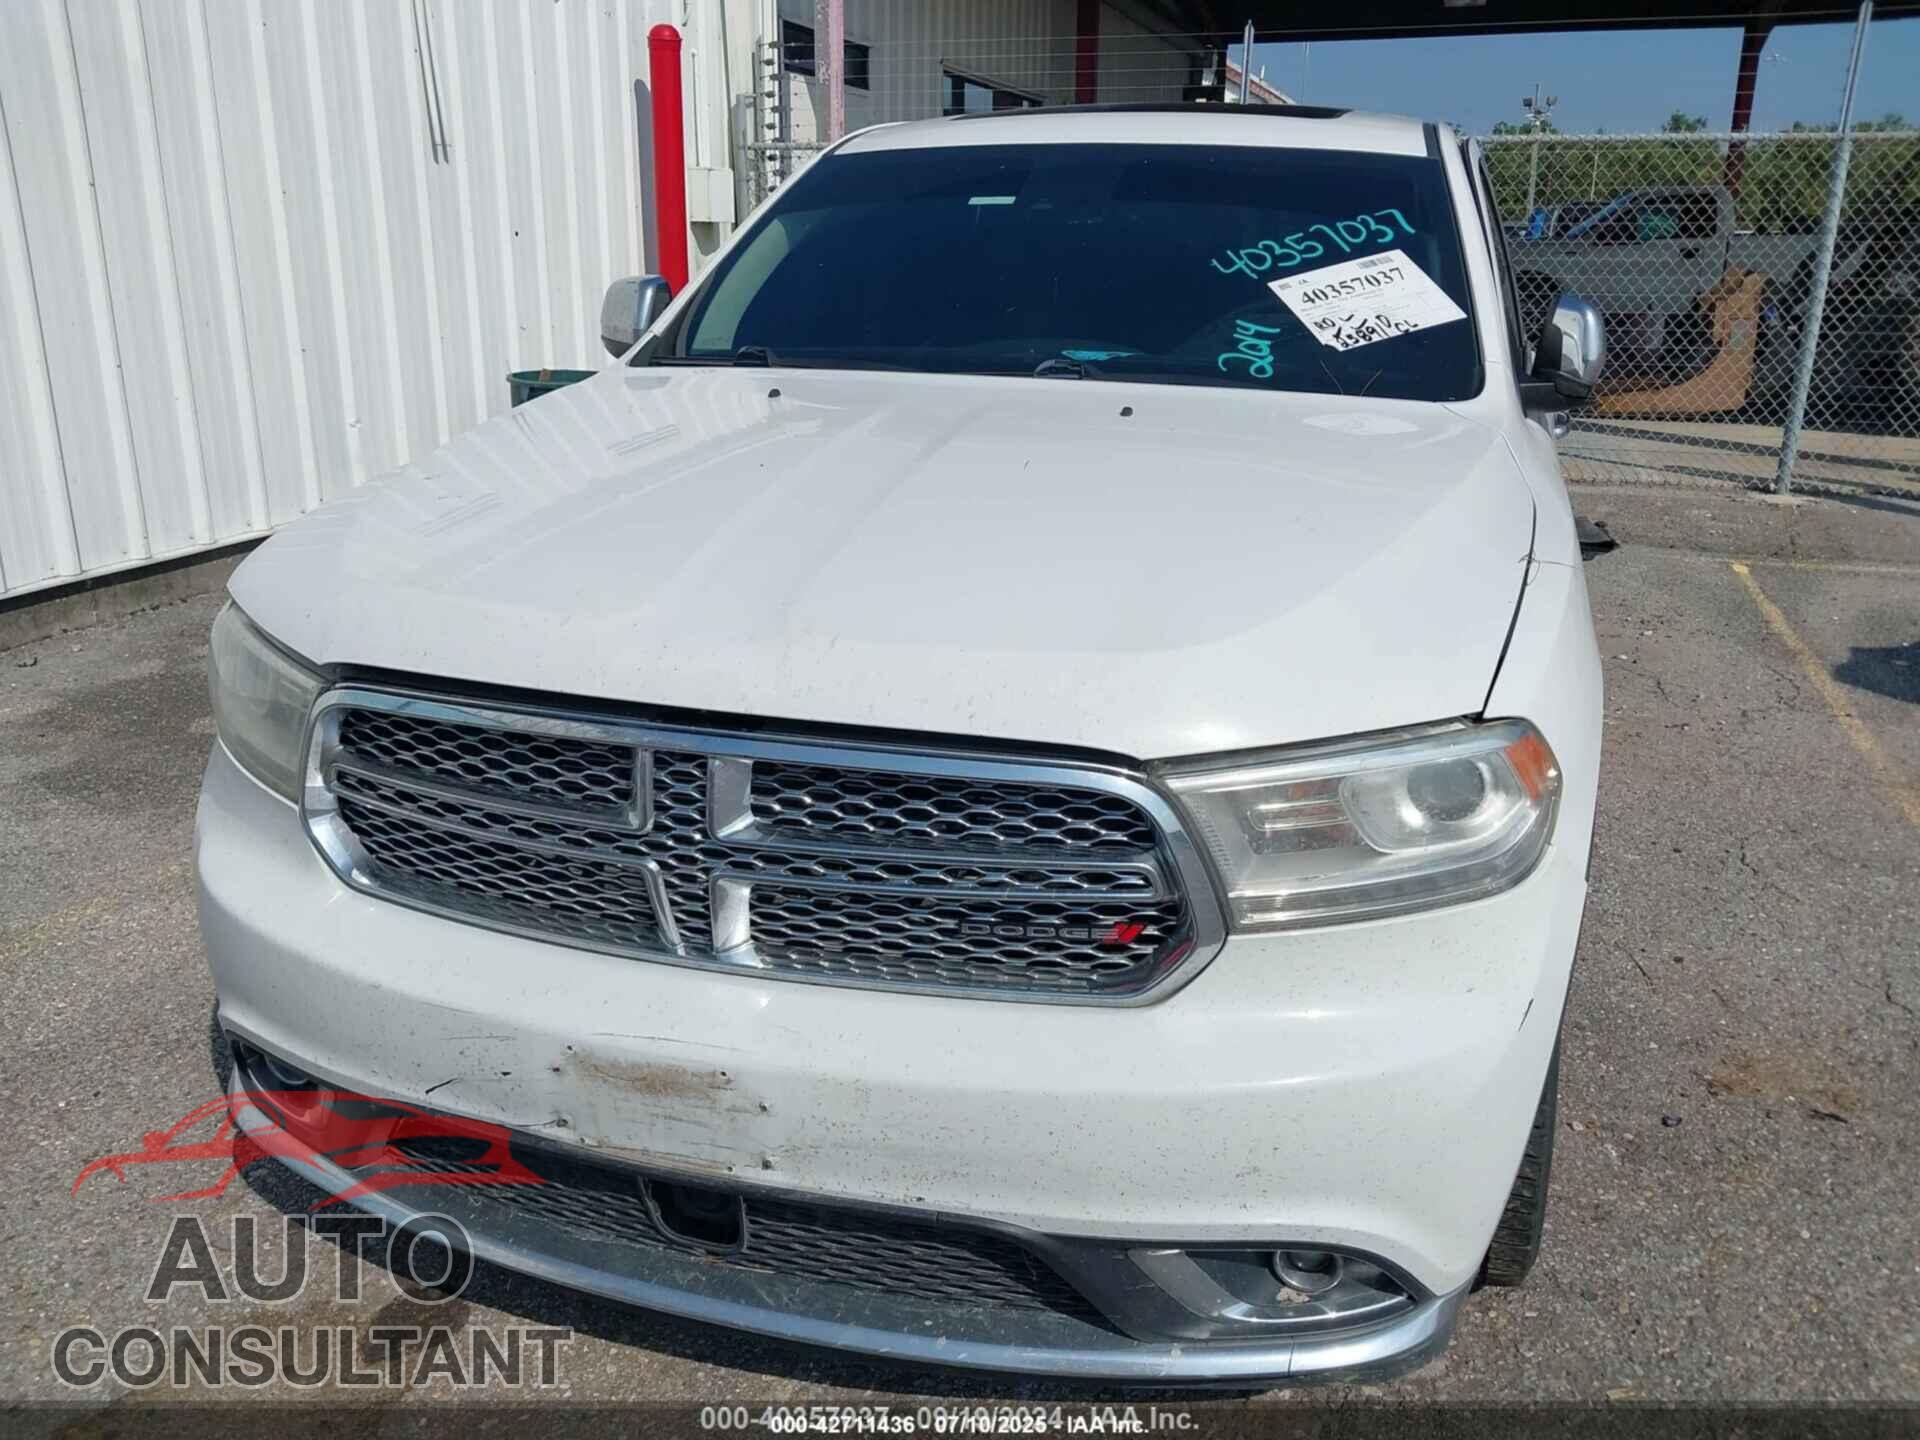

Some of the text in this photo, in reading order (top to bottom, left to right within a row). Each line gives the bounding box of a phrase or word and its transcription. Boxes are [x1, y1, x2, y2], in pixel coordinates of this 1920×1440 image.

[1210, 208, 1416, 280] 40357037
[1301, 266, 1406, 305] 40357037
[1217, 319, 1281, 378] 2014
